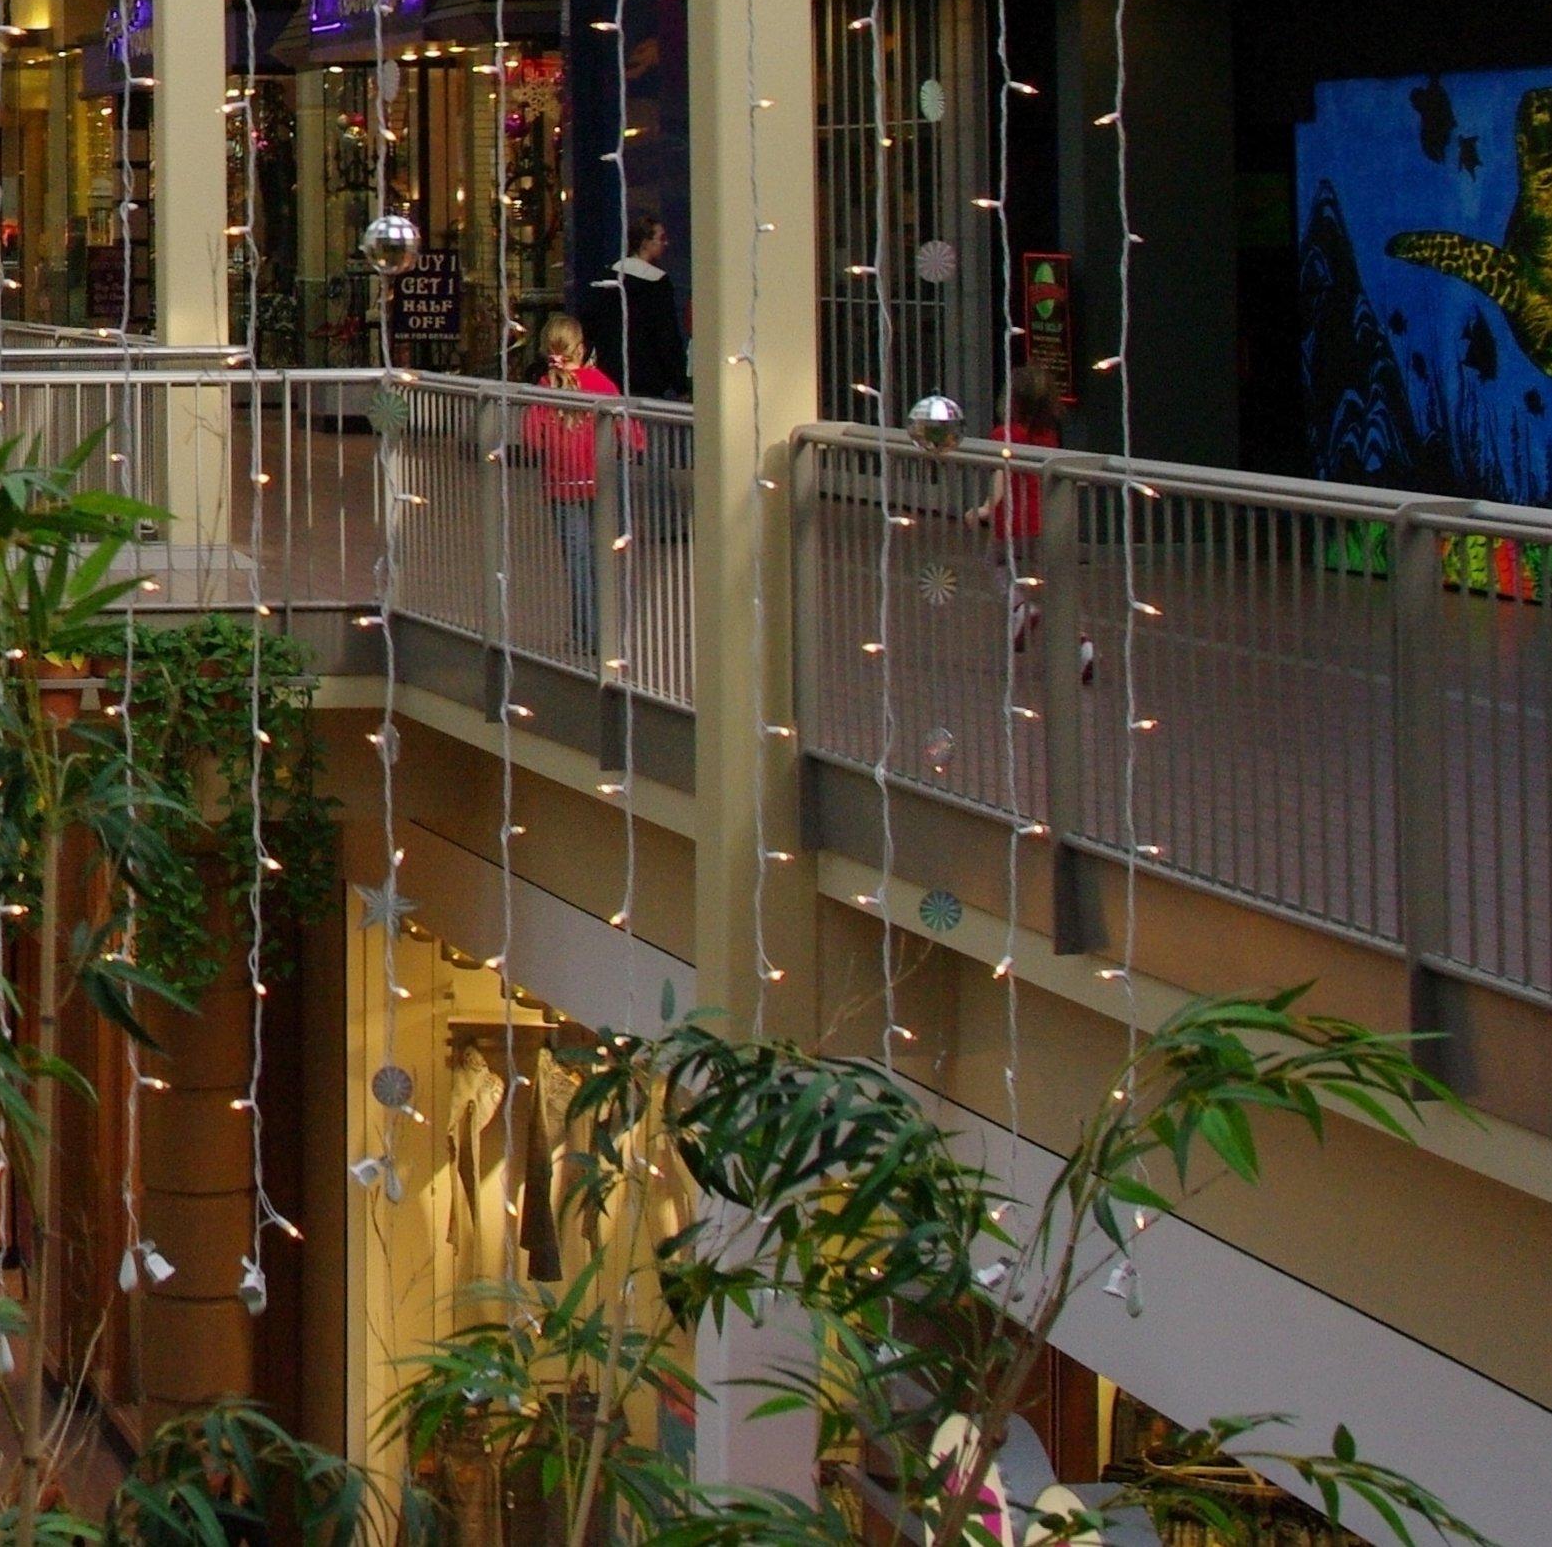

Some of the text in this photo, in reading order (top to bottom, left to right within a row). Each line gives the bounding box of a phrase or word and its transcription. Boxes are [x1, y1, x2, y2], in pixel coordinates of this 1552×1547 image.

[400, 276, 442, 294] GET
[402, 299, 453, 313] HALF
[408, 315, 446, 329] OFF
